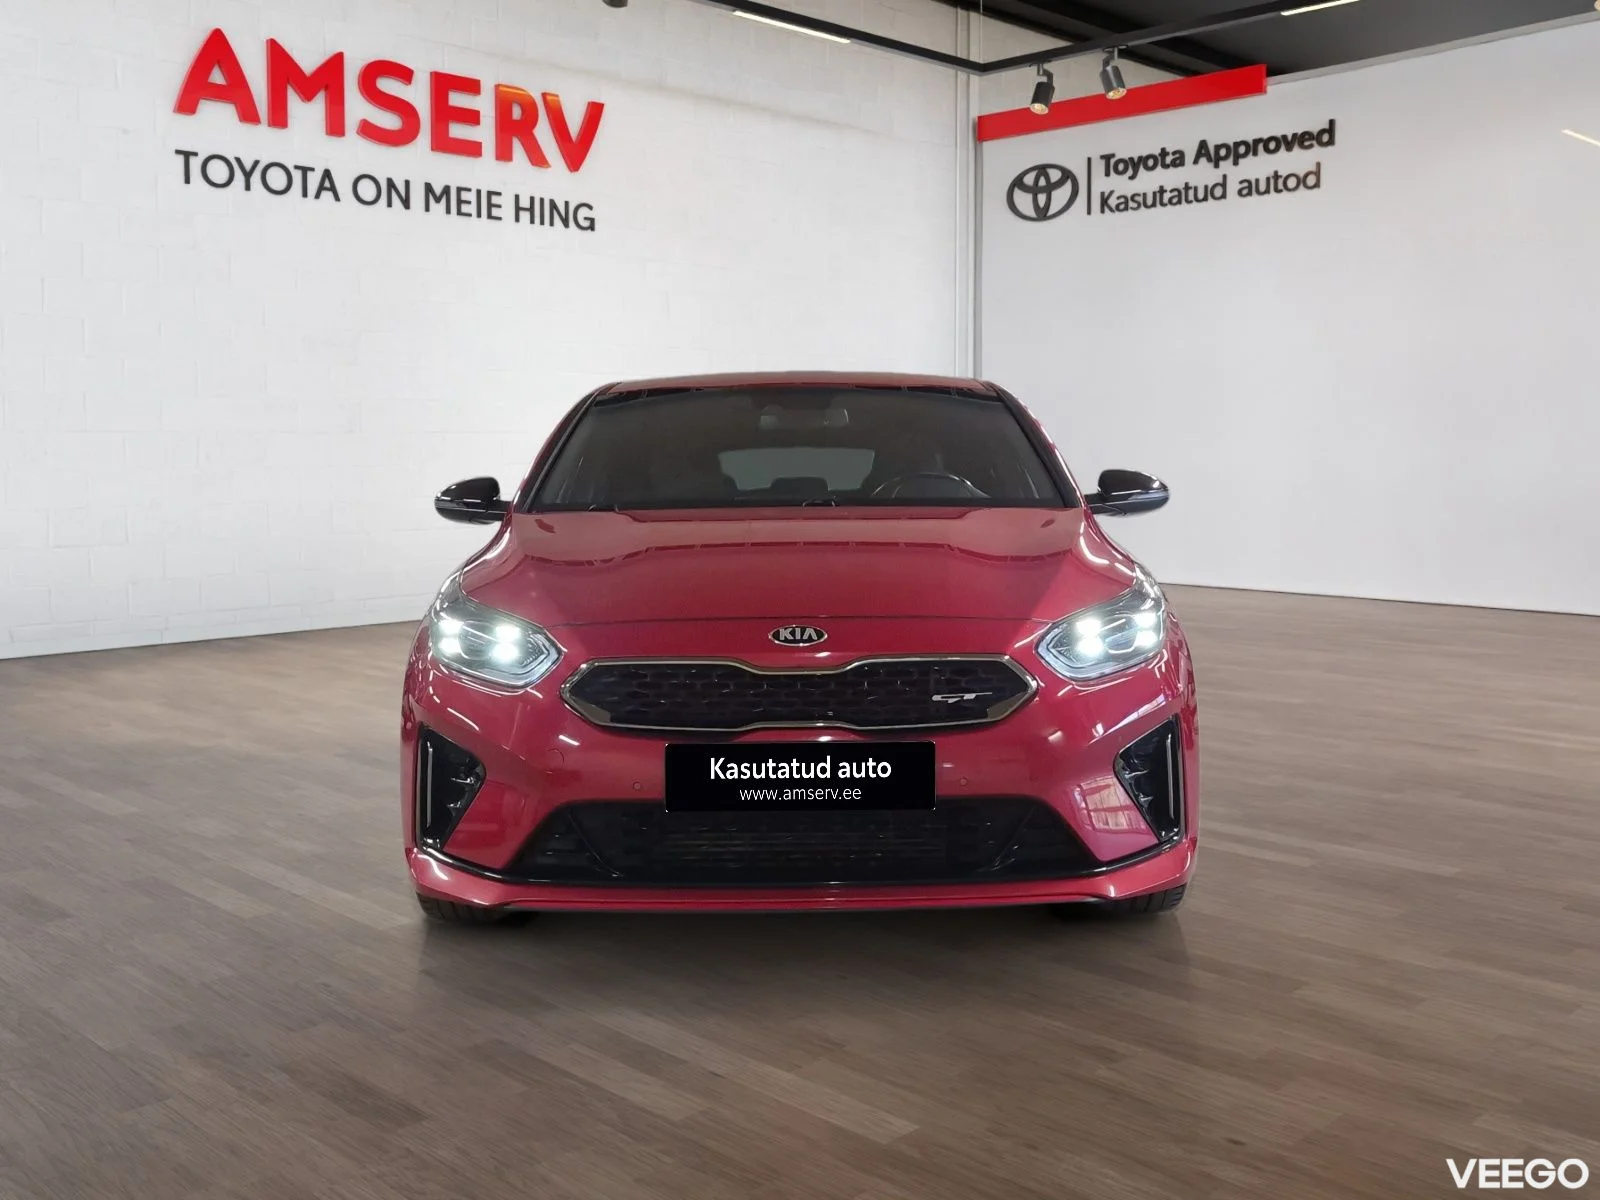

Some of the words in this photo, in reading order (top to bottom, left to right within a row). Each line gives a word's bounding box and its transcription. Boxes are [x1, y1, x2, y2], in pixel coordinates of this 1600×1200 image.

[173, 28, 604, 172] AMSERV
[1100, 147, 1185, 180] Toyota
[1193, 119, 1336, 167] Approved
[175, 149, 340, 201] TOYOTA
[352, 173, 411, 210] ON
[424, 182, 502, 221] MEIE
[514, 194, 596, 232] HING
[1100, 174, 1227, 214] Kasutatud
[1237, 162, 1321, 198] autod
[779, 627, 818, 641] KIA
